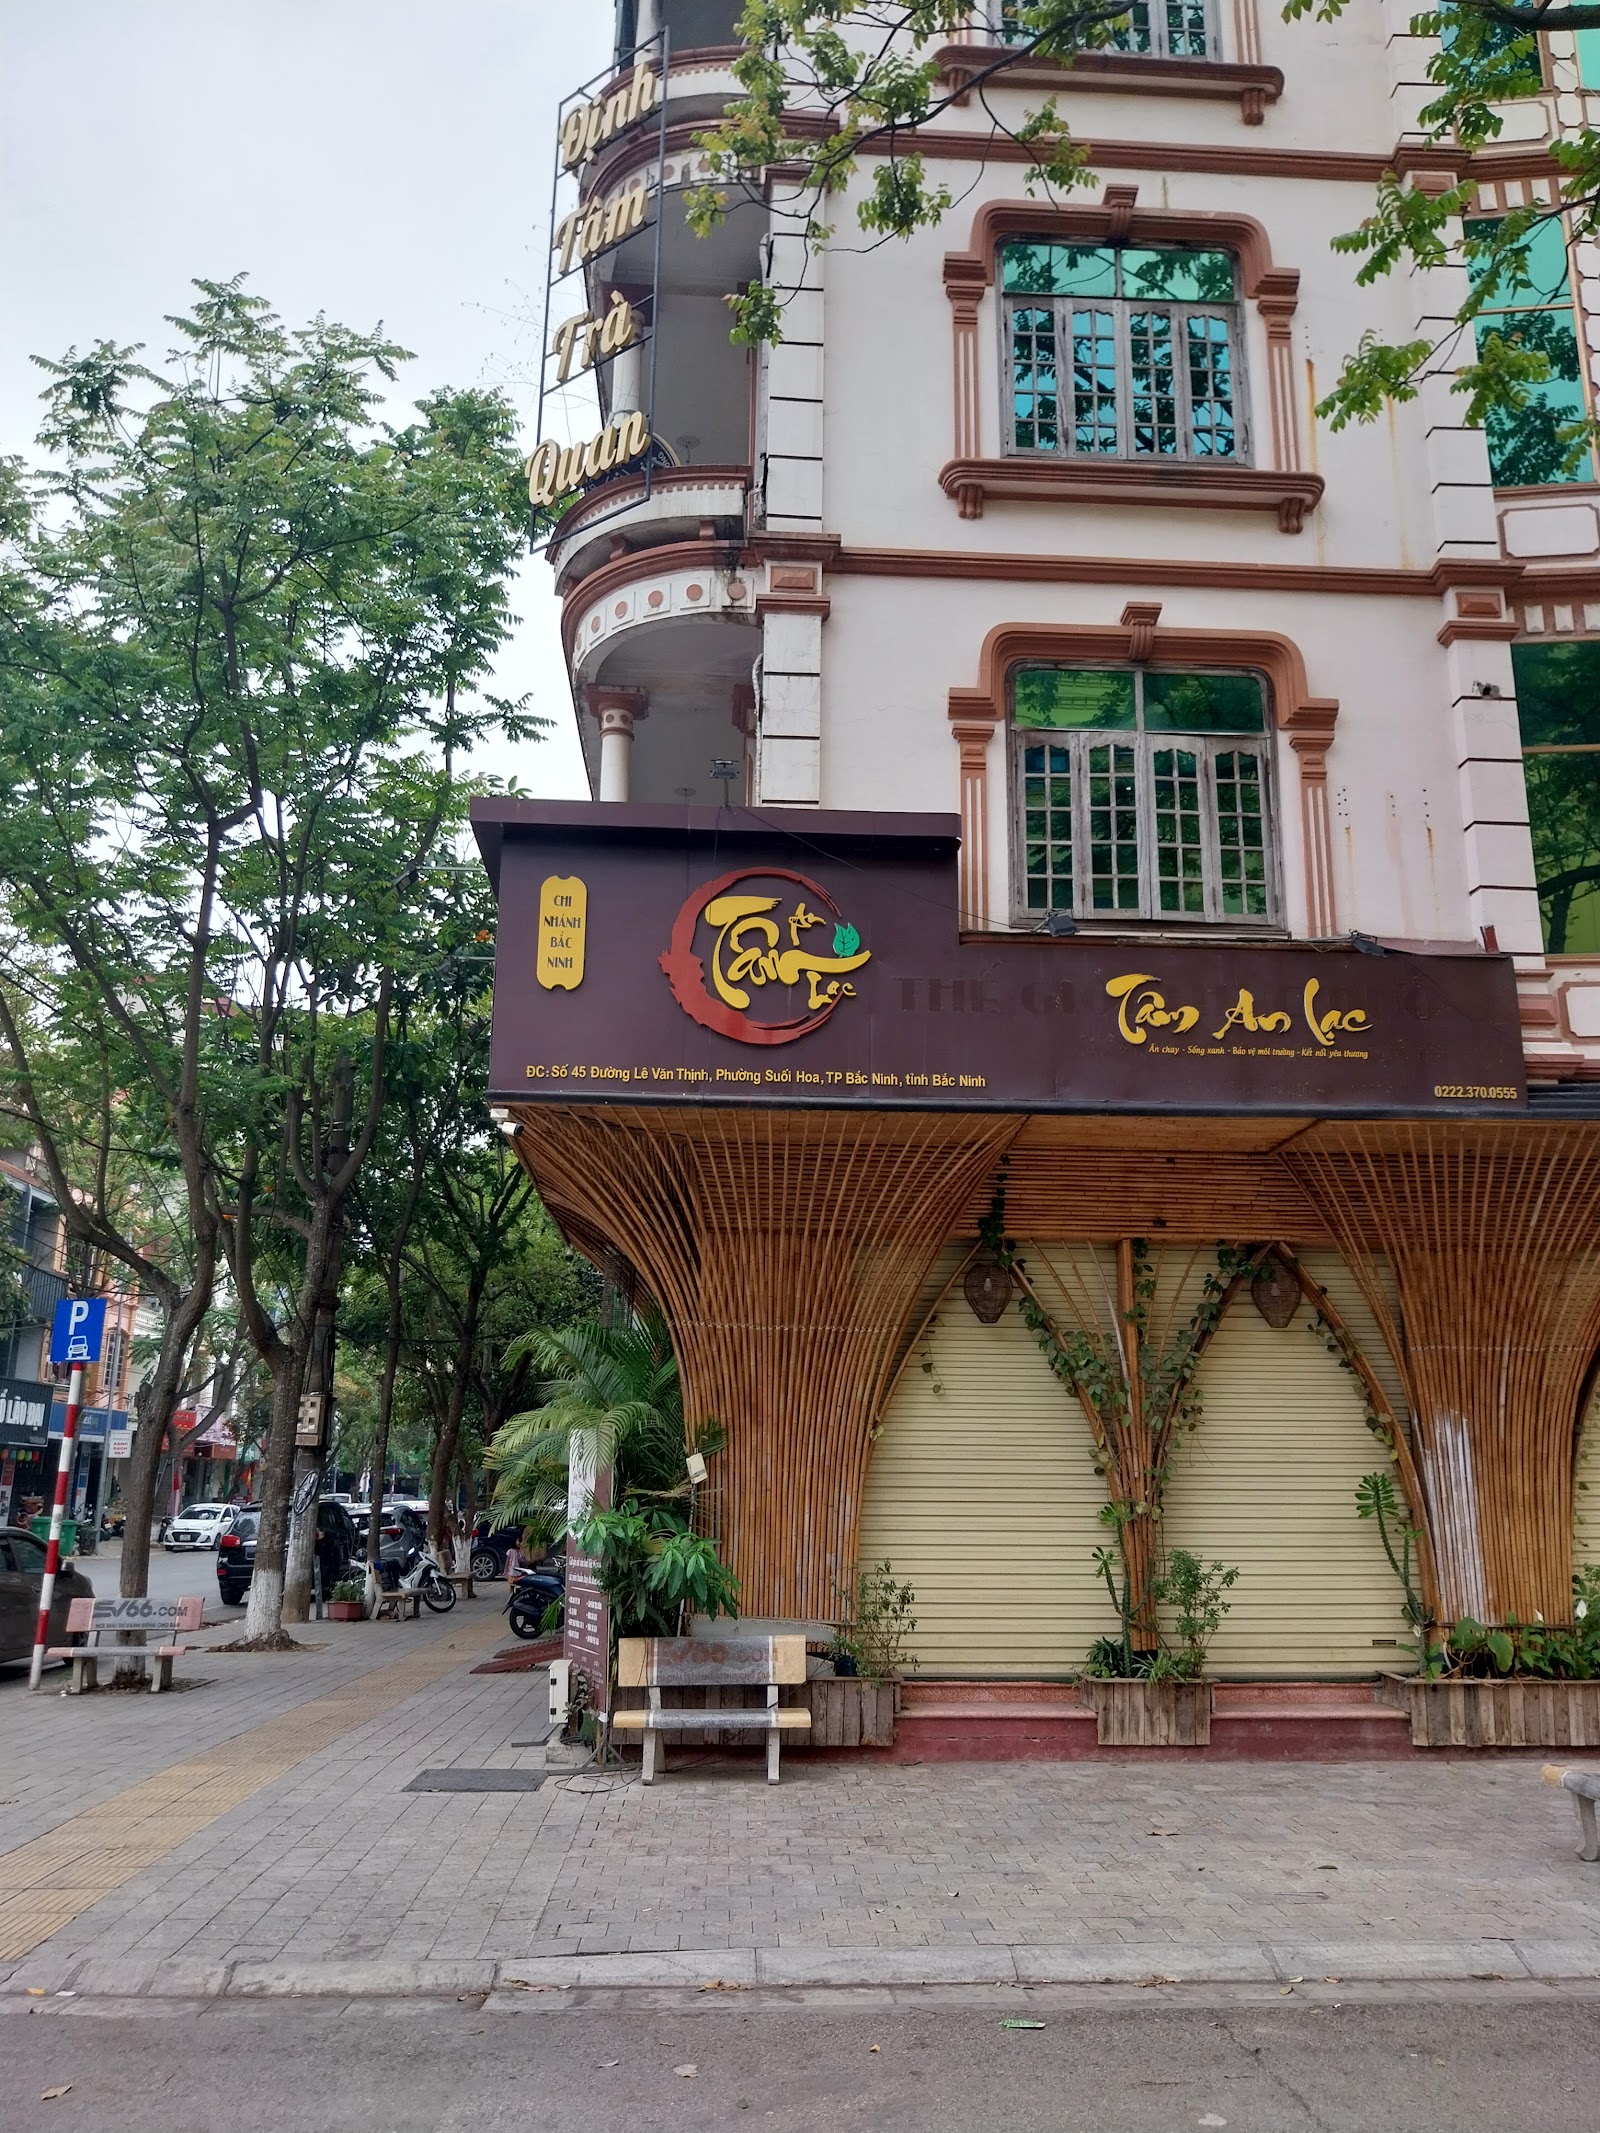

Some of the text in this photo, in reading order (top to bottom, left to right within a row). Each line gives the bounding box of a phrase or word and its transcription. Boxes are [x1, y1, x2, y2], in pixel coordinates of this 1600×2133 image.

[554, 187, 648, 275] Tâm
[553, 290, 636, 383] Trà
[553, 895, 572, 907] CHI
[543, 914, 581, 928] NHÁNH
[549, 931, 572, 948] BẮC
[547, 956, 573, 968] NINH
[705, 896, 872, 1009] Tâm
[1105, 973, 1199, 1044] Tâm
[1212, 988, 1291, 1039] An
[1161, 1045, 1180, 1055] chay
[1187, 1045, 1205, 1056] Sống
[1207, 1047, 1224, 1055] xanh
[551, 1064, 569, 1077] Số
[571, 1065, 586, 1077] 45
[590, 1066, 630, 1082] Đường
[634, 1067, 649, 1079] Lê
[652, 1067, 674, 1080] Văn
[677, 1068, 712, 1083] Thịnh,
[716, 1069, 761, 1085] Phường
[764, 1069, 792, 1082] Suối
[796, 1071, 825, 1085] Hoa,
[826, 1071, 843, 1083] TP
[846, 1071, 868, 1084] Bắc
[872, 1072, 903, 1087] Ninh,
[906, 1073, 929, 1086] tỉnh
[932, 1073, 956, 1087] Bắc
[959, 1074, 986, 1087] Ninh
[1434, 1085, 1517, 1099] 0222.370.0555
[69, 1301, 89, 1335] P
